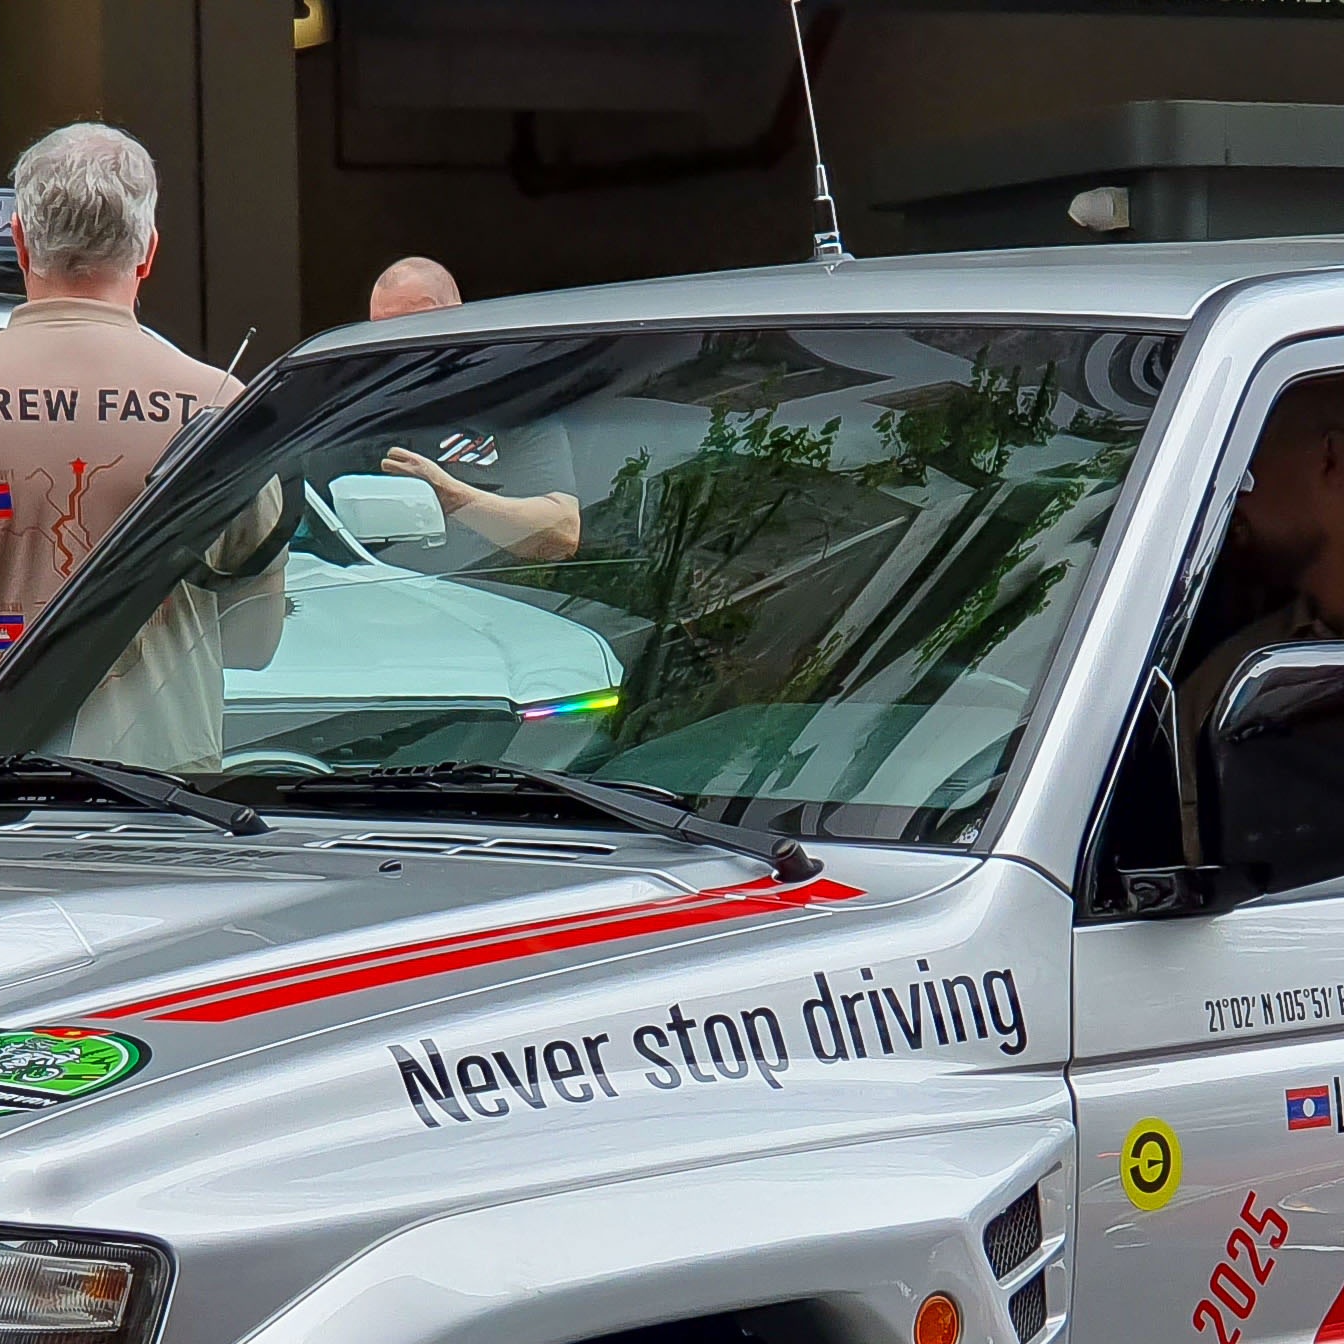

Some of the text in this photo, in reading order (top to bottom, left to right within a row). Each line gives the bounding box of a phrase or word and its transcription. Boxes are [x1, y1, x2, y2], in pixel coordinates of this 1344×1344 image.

[98, 389, 198, 426] FAST
[1260, 993, 1275, 1025] N
[388, 959, 1028, 1128] Never stop driving
